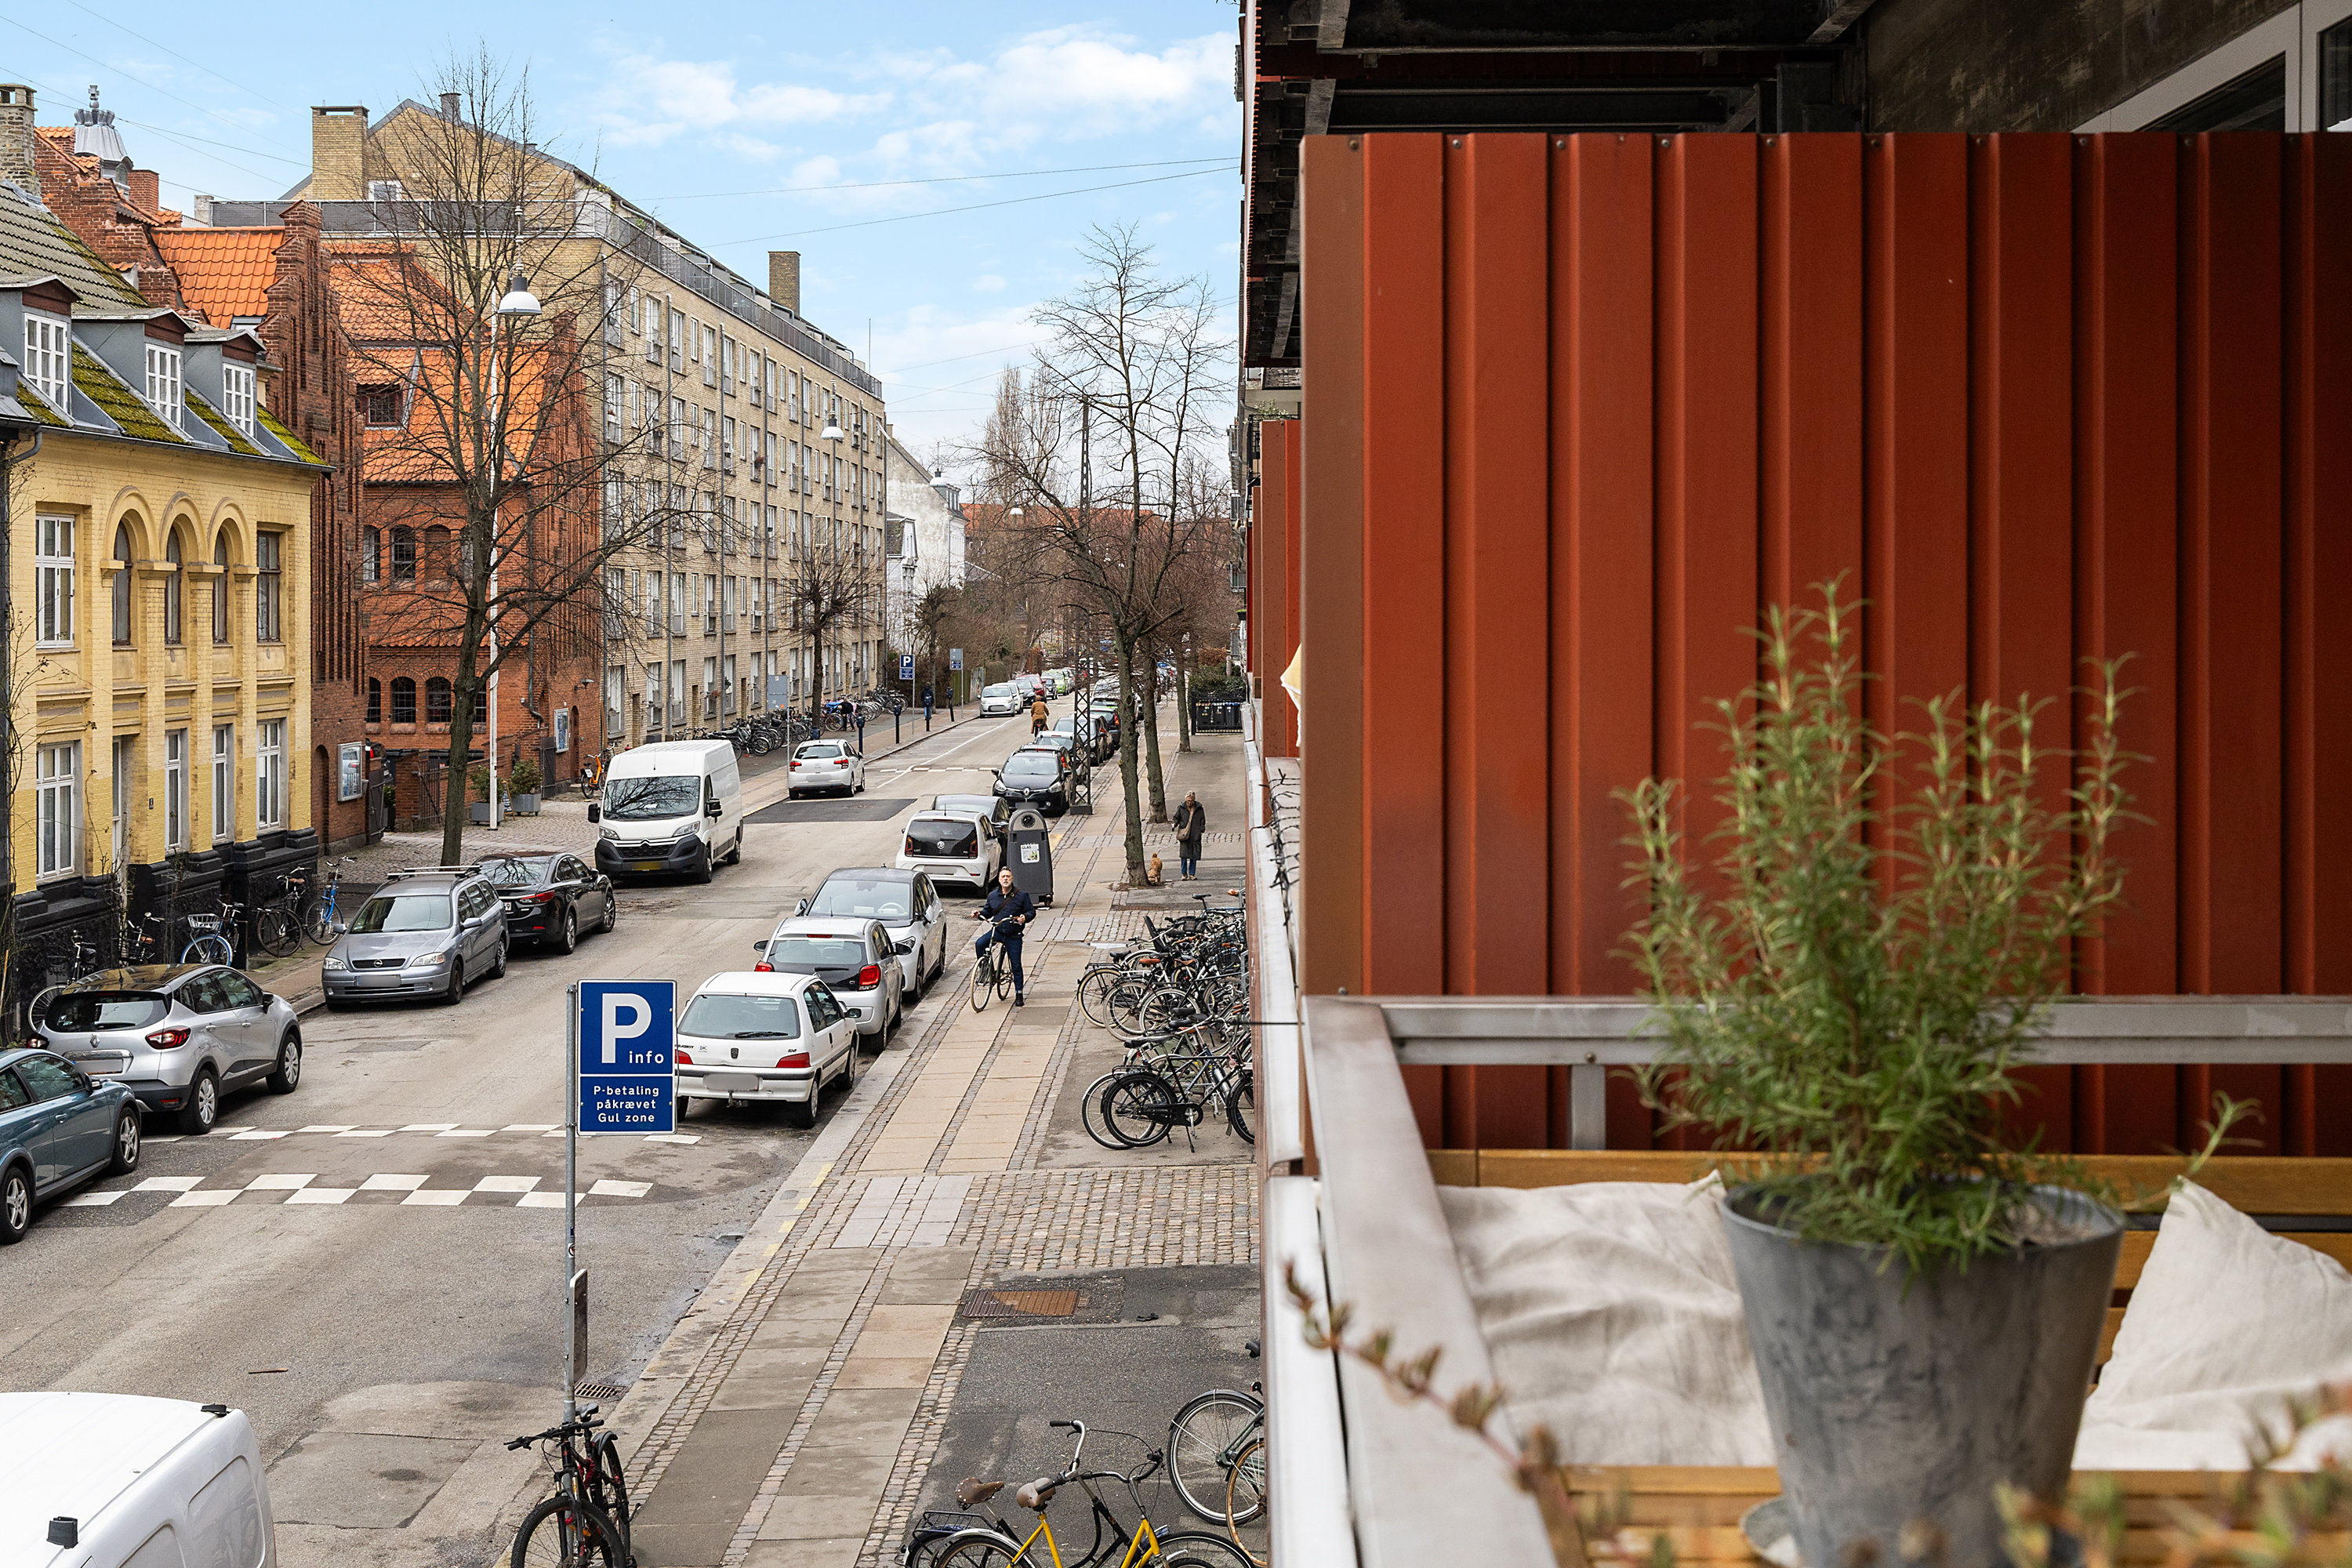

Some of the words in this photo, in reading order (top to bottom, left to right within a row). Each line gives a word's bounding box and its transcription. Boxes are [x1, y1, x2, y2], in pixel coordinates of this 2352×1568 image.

[903, 656, 911, 666] P
[601, 993, 652, 1064] P
[629, 1050, 665, 1064] info
[593, 1085, 659, 1097] P-betaling
[597, 1099, 656, 1110] påkrævet
[597, 1112, 619, 1123] Gul
[625, 1114, 655, 1123] zone
